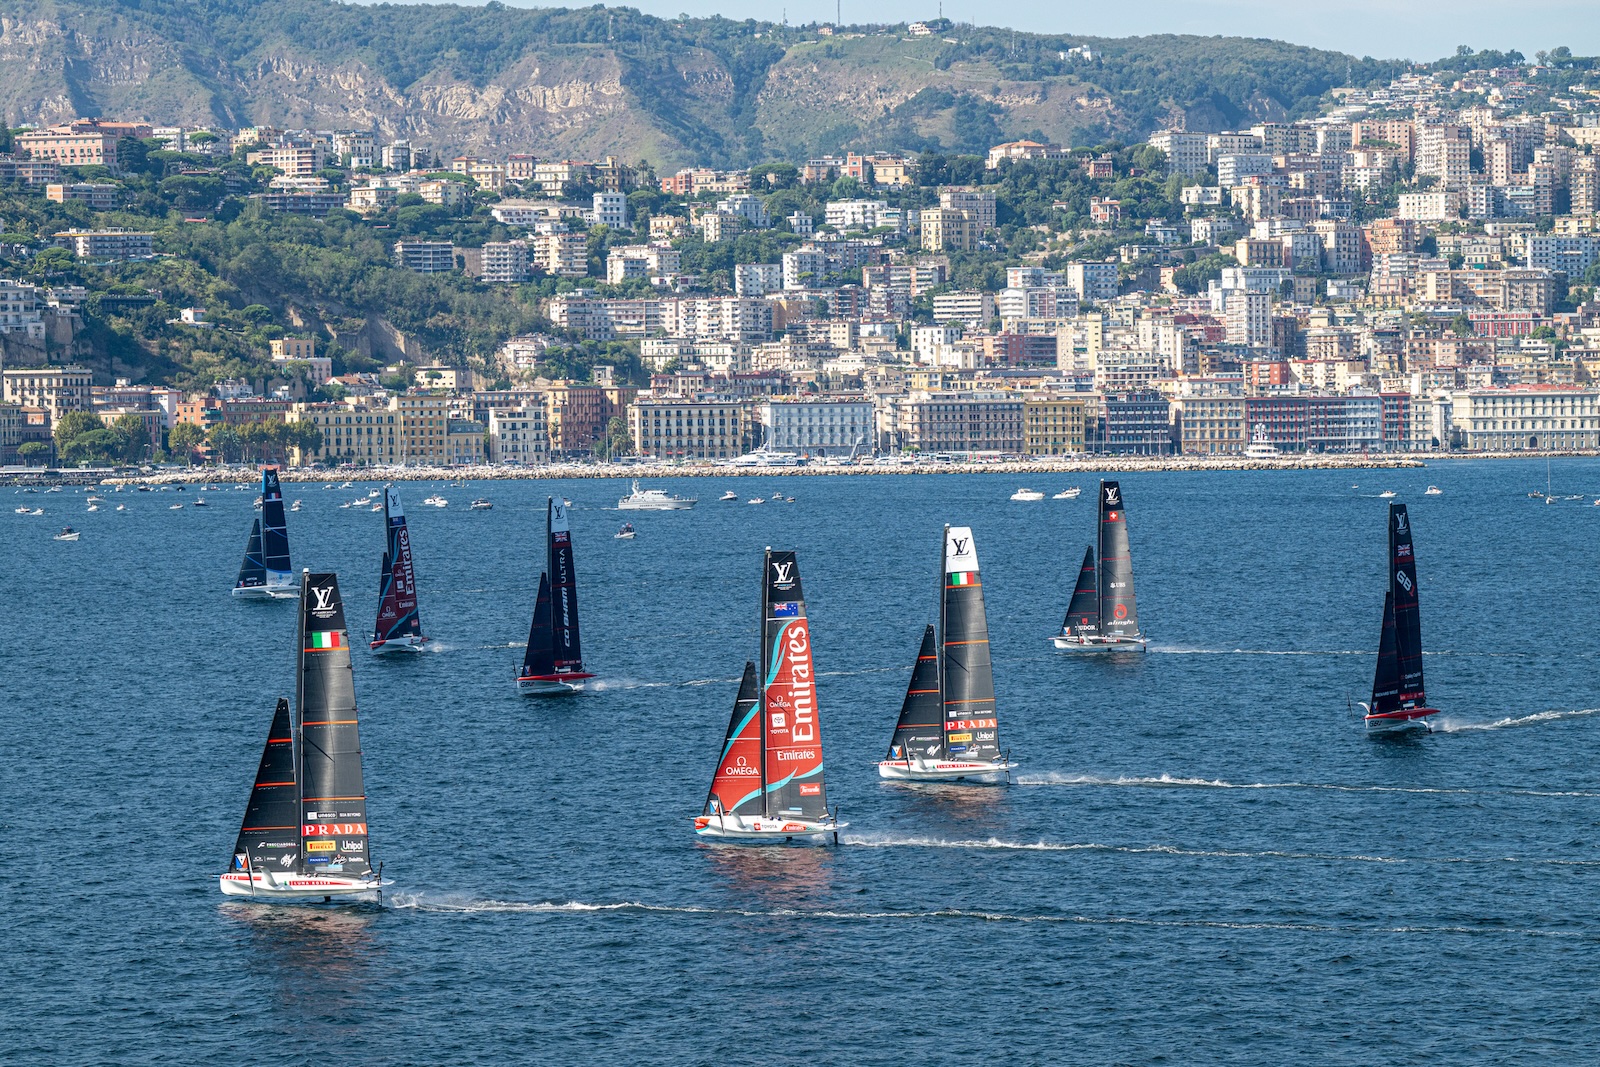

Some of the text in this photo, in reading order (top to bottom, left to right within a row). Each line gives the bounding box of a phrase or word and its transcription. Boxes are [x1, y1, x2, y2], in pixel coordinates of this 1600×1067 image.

[400, 529, 414, 595] Emirates
[787, 626, 814, 743] Emirates
[947, 719, 996, 730] PRADA
[976, 731, 995, 741] Unipol
[777, 750, 815, 761] Emirates
[726, 766, 760, 776] OMEGA
[305, 824, 365, 836] PRADA
[342, 840, 363, 852] Unipol
